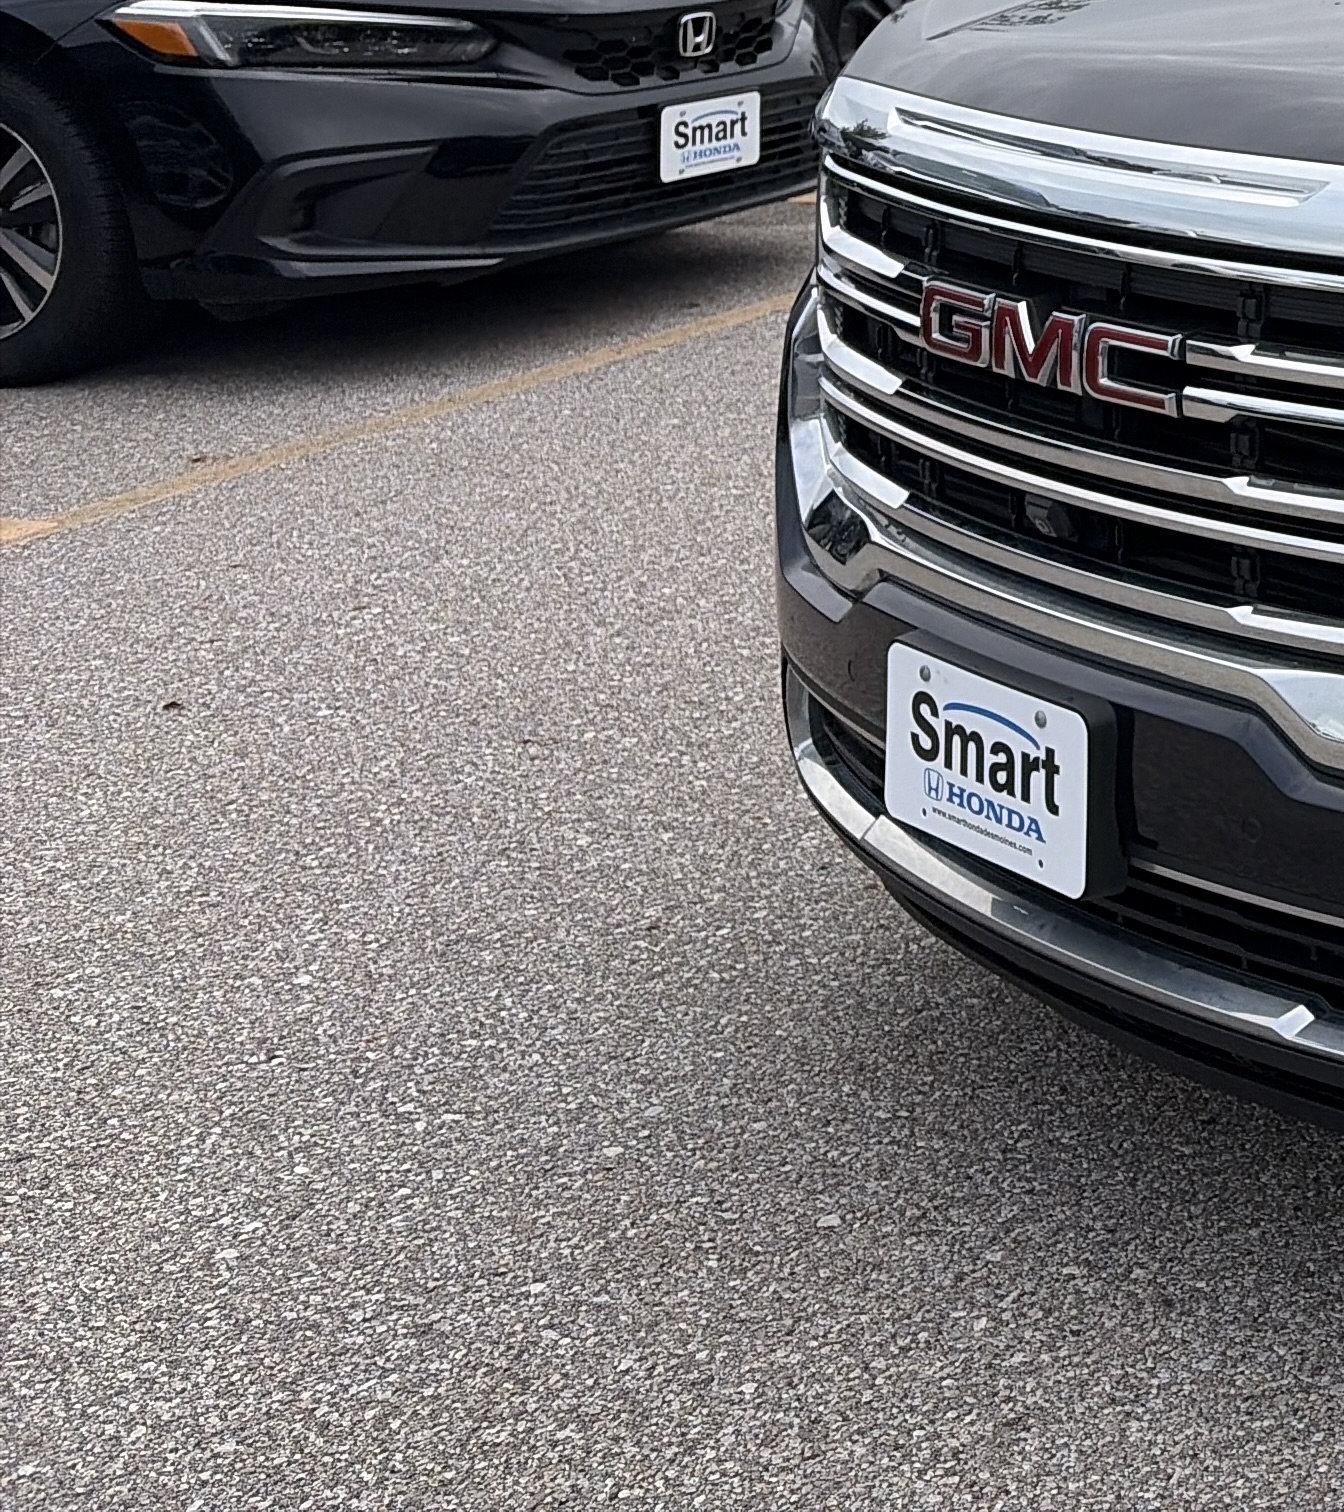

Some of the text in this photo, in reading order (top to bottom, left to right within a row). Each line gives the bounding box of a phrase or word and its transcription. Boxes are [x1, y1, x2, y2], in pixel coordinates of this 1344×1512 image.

[674, 111, 748, 150] Smart
[692, 142, 741, 160] HONDA
[919, 275, 1183, 419] GMC
[910, 690, 1060, 817] Smart
[946, 781, 1046, 844] HONDA
